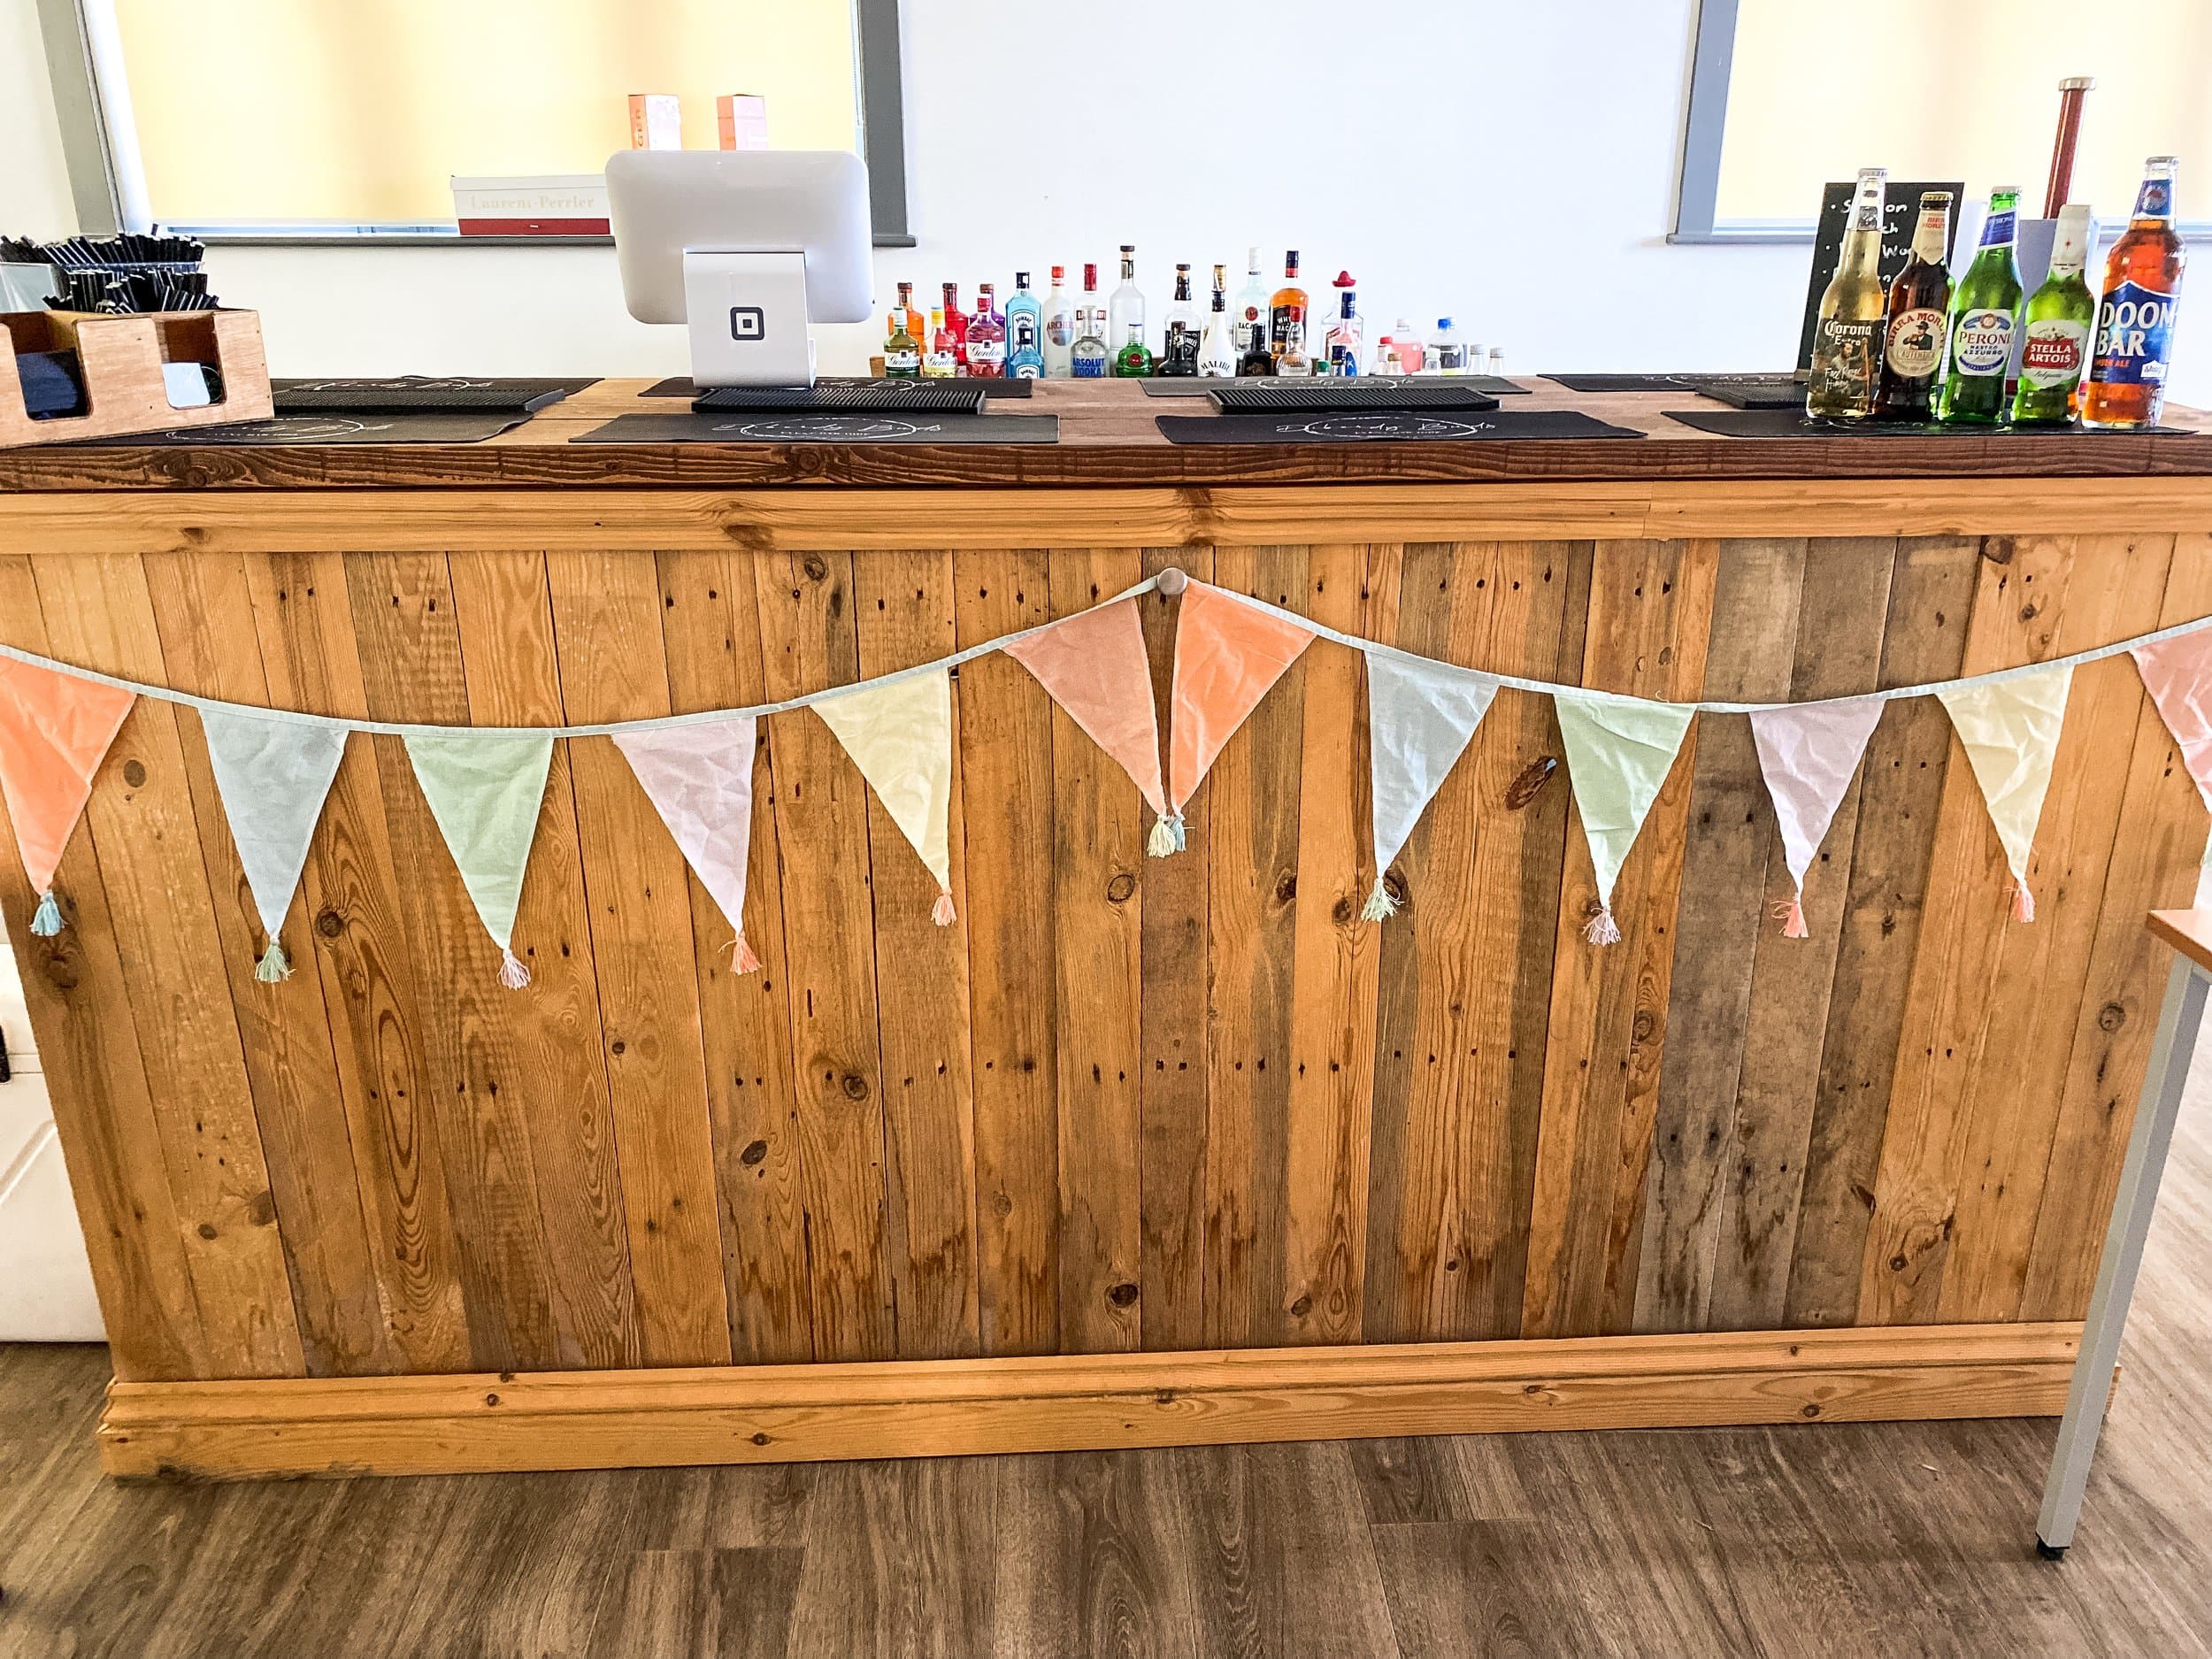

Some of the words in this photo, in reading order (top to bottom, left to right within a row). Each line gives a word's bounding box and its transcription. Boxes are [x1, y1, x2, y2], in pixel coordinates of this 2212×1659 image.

[470, 194, 595, 210] Laurent-Perrier
[2101, 301, 2177, 329] DOOM
[1824, 319, 1872, 338] Corona
[1888, 315, 1915, 347] BIRRA
[1959, 332, 2011, 344] PERONI
[2095, 330, 2146, 357] BAR
[2030, 343, 2071, 353] STELLA
[1072, 357, 1105, 366] ABSOLUT
[2029, 354, 2070, 363] ARTOIS
[1074, 366, 1102, 376] VODKA
[1201, 360, 1232, 373] MALIBU
